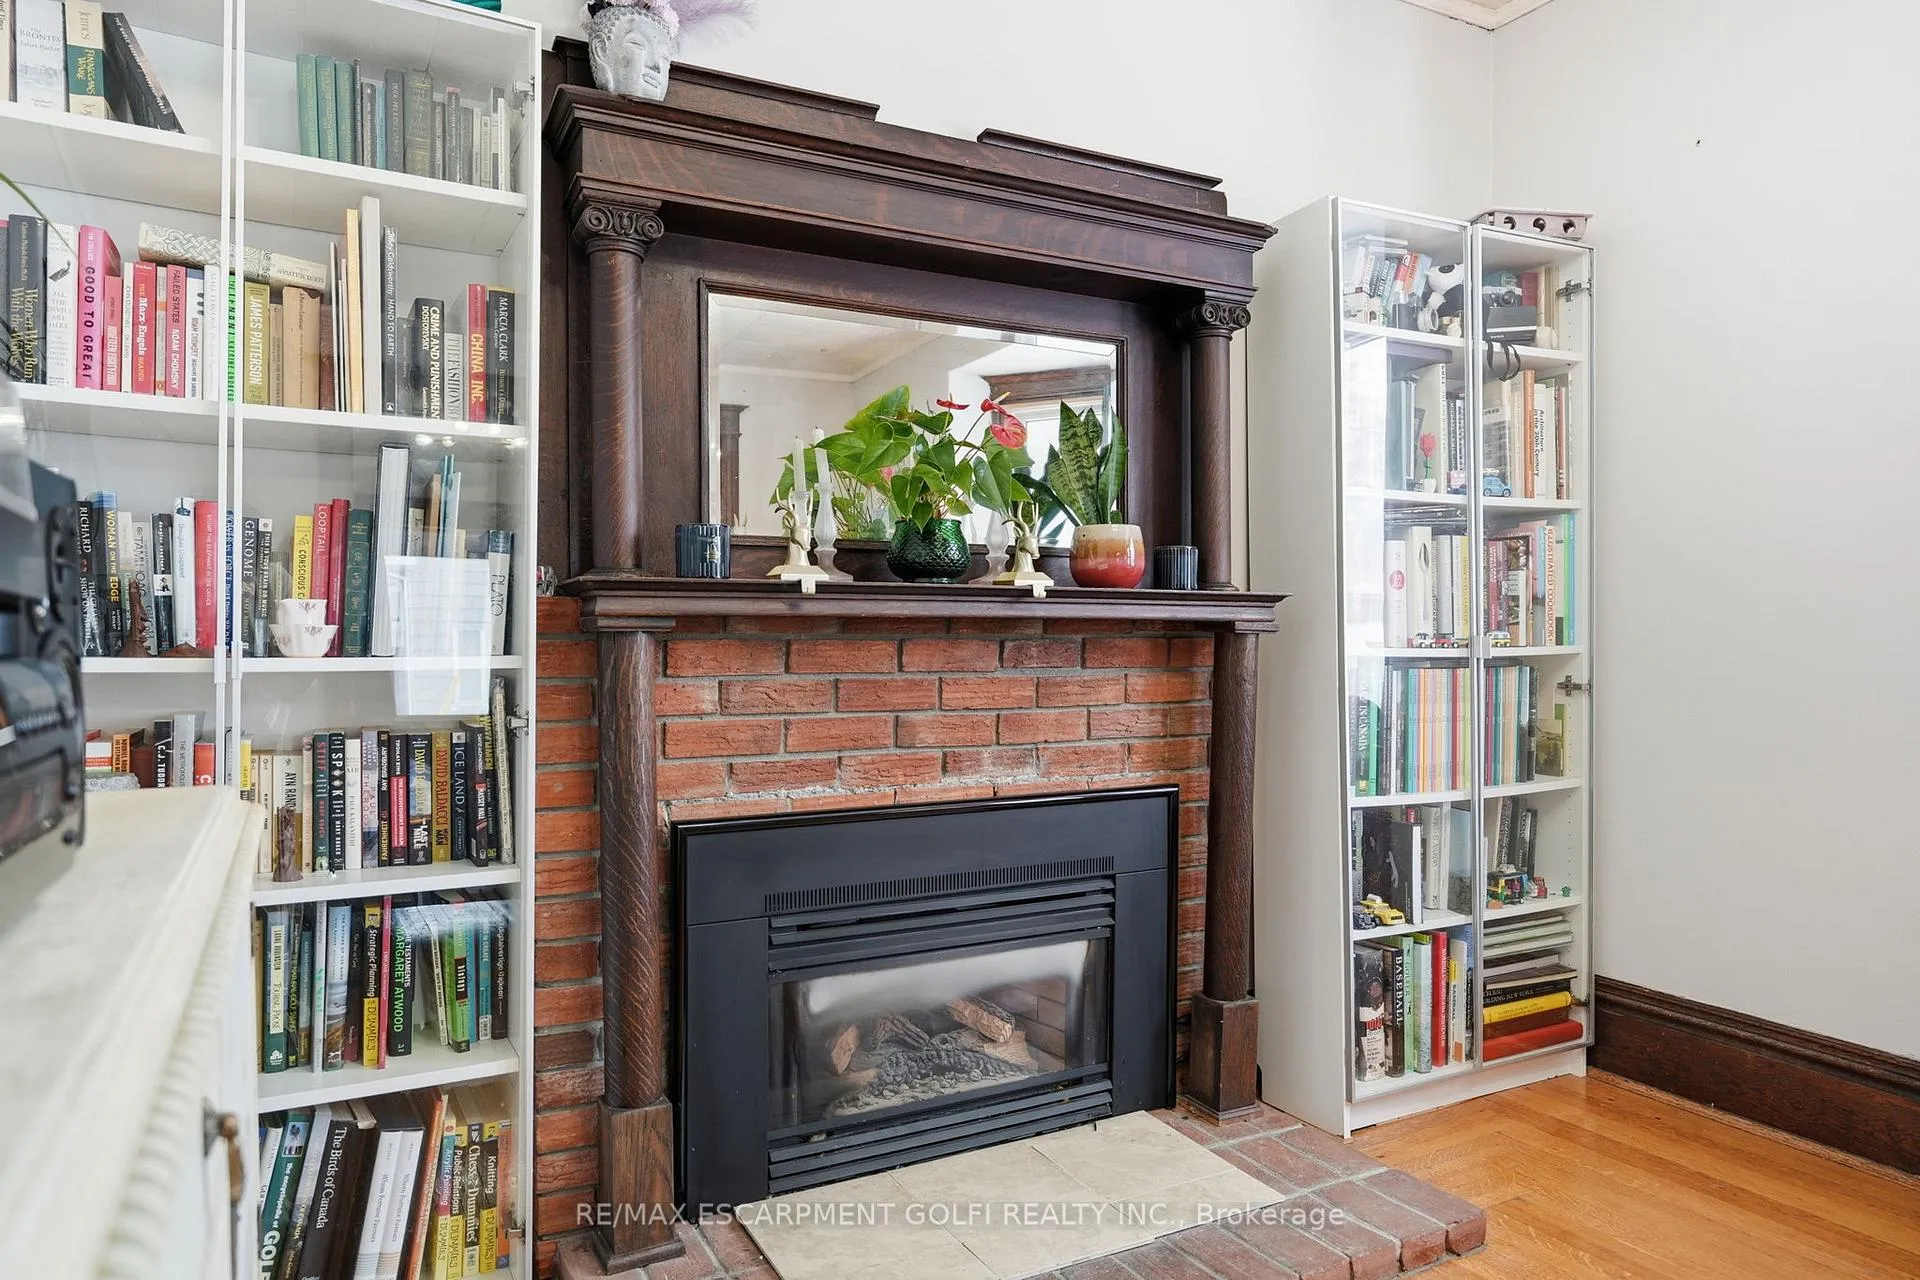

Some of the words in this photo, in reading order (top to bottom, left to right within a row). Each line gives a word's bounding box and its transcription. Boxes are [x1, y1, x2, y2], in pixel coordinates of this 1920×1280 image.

[84, 267, 95, 304] GOOD
[172, 269, 180, 296] FAILED
[386, 252, 395, 295] Goldsworthy
[11, 287, 24, 312] With
[25, 288, 38, 329] Women
[172, 297, 180, 324] STATES
[249, 296, 262, 329] JAMES
[499, 297, 508, 331] MARCIA
[11, 315, 24, 331] the
[83, 311, 95, 328] TO
[387, 322, 394, 332] TO
[422, 305, 430, 350] DOSTOYEVSKY
[430, 306, 440, 337] CRIME
[10, 331, 23, 367] Wolves
[25, 330, 37, 356] Who
[171, 329, 180, 352] NOAM
[430, 338, 440, 359] AND
[471, 334, 484, 373] CHINA
[499, 332, 508, 362] CLARK
[24, 356, 36, 379] Run
[82, 334, 94, 379] GREAT
[171, 353, 180, 389] CHOMSKY
[249, 330, 262, 385] PATTERSON
[471, 379, 484, 404] INC.
[79, 506, 91, 553] RICHARD
[106, 510, 117, 549] WOMAN
[177, 523, 185, 548] Douglas
[317, 505, 328, 554] LOOPTAIL
[110, 551, 117, 561] ON
[243, 520, 255, 577] GENOME
[177, 549, 185, 578] Coupland
[298, 550, 307, 590] CONSCIOUS
[79, 577, 89, 600] SHOW
[110, 576, 119, 602] EDGE
[262, 590, 268, 598] ON
[491, 574, 505, 617] PLATO
[81, 602, 89, 612] ON
[1359, 704, 1367, 715] IN
[1358, 716, 1368, 751] CANADA
[157, 745, 165, 762] C.J.
[317, 741, 325, 771] STIFF
[415, 749, 426, 774] DAVID
[436, 748, 449, 777] DAVID
[454, 746, 465, 766] ICE
[157, 763, 165, 788] TUDOR
[285, 772, 296, 786] AYN
[454, 771, 465, 805] LAND
[285, 789, 296, 807] RAND
[414, 775, 425, 815] BALDACCI
[436, 781, 449, 825] BALDACCI
[477, 788, 485, 807] MASSEY
[477, 807, 485, 820] HALL
[413, 828, 421, 850] MILE
[420, 825, 428, 848] LAST
[436, 829, 444, 846] MAN
[367, 929, 377, 962] Strategic
[395, 926, 404, 983] MARGARET
[366, 963, 377, 997] Planning
[457, 965, 466, 992] biology
[1395, 956, 1403, 1025] BASEBALL
[393, 987, 404, 1032] ATWOOD
[366, 1006, 376, 1051] DUMMIES
[332, 1127, 347, 1148] The
[284, 1163, 293, 1174] the
[326, 1149, 343, 1176] Birds
[443, 1148, 452, 1174] Acrylic
[454, 1150, 463, 1175] Public
[468, 1145, 480, 1175] Chess
[485, 1155, 496, 1194] Knitting
[273, 1175, 290, 1219] encyclopedia
[324, 1177, 335, 1188] of
[379, 1173, 389, 1194] Whom
[400, 1173, 410, 1193] Whom
[440, 1174, 450, 1206] Painting
[452, 1176, 461, 1214] Relations
[316, 1188, 335, 1229] Canada
[466, 1188, 480, 1242] Dummies
[272, 1220, 279, 1228] of
[485, 1217, 495, 1260] DUMMIES
[438, 1223, 447, 1261] DUMMIES
[450, 1224, 459, 1268] DUMMIES
